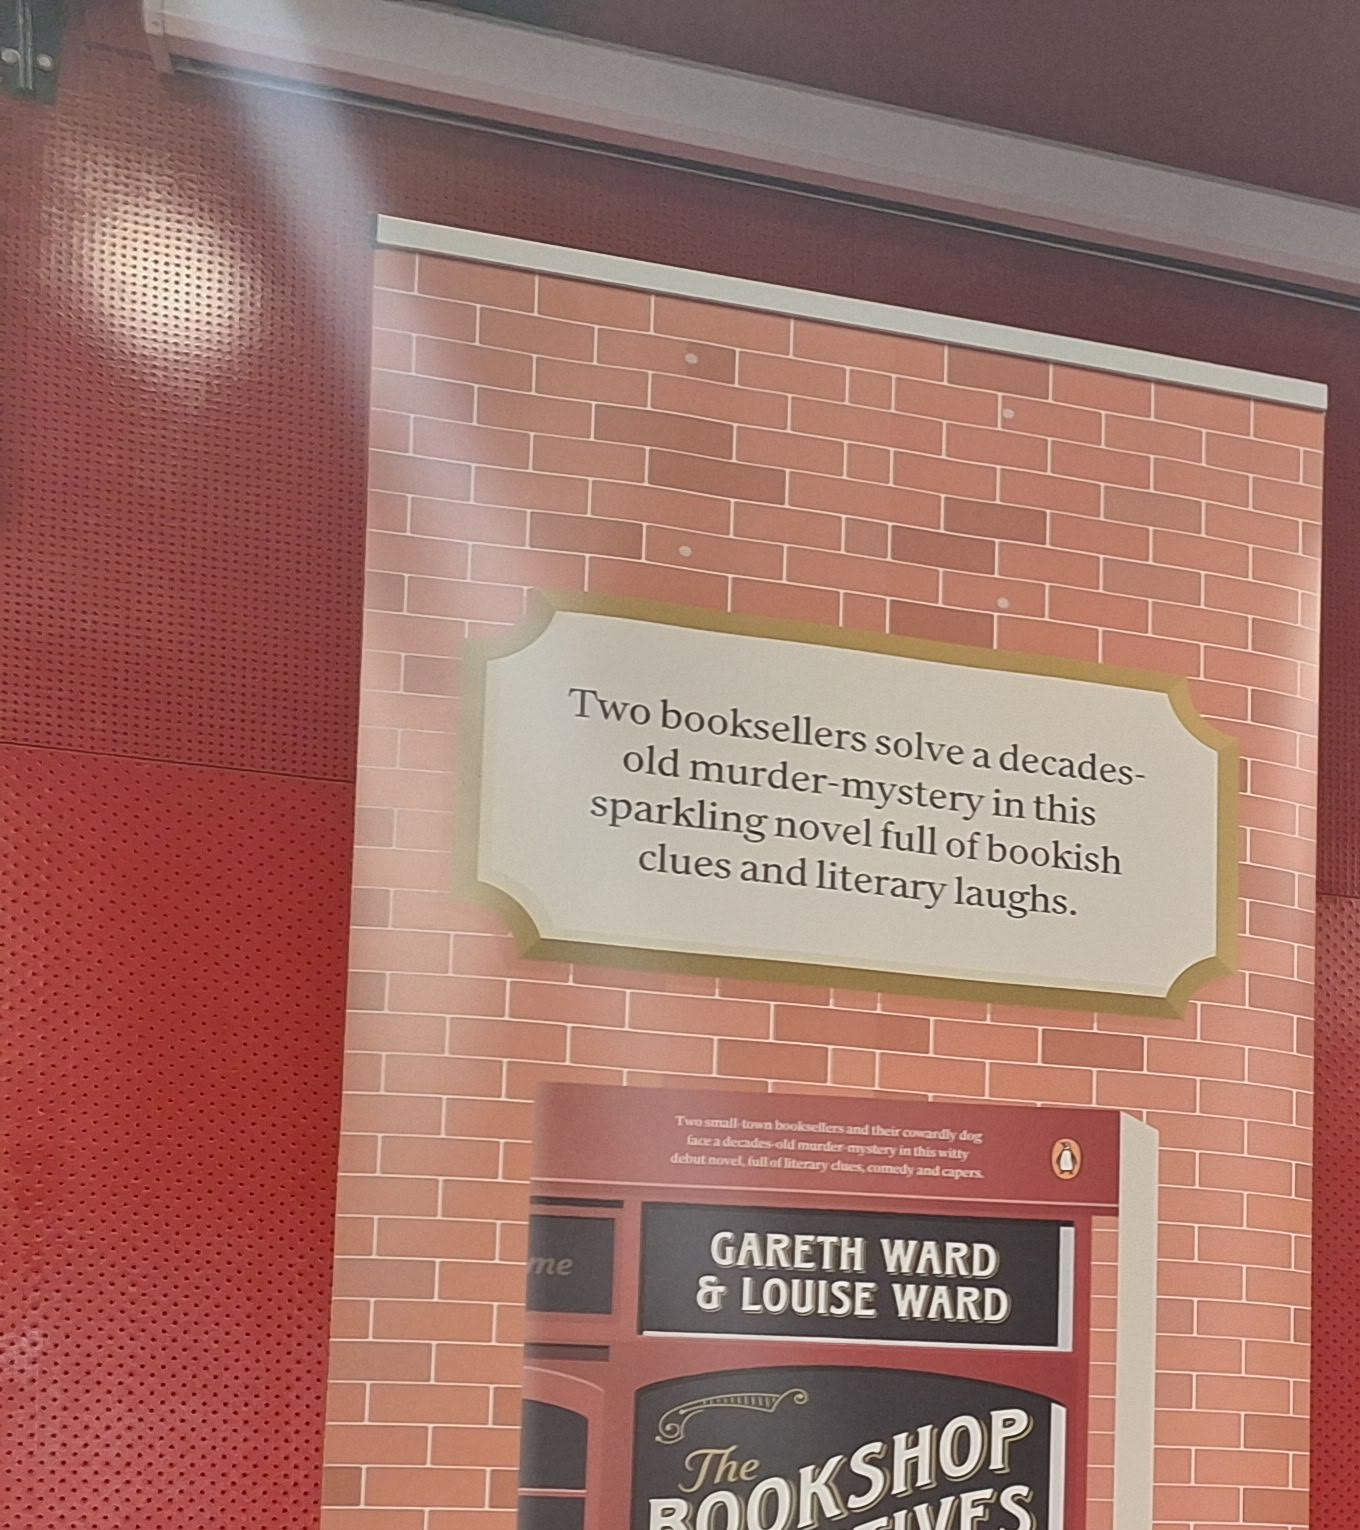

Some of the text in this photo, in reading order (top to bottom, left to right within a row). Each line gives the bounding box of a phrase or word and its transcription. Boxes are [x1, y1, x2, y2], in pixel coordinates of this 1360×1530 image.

[568, 688, 1147, 785] Two booksellers solve a decades-
[623, 745, 1097, 826] old murder-mystery in this
[590, 795, 1123, 875] sparkling novel full of bookish
[638, 843, 1077, 919] clues and literary laughs.
[674, 1115, 984, 1144] Two small-town booksellers and their cowardly dog
[687, 1135, 970, 1162] face a decades-old murder-mystery in this witty
[670, 1153, 985, 1181] debut novel, full of literary clues, comedy and capers.
[710, 1231, 1000, 1279] GARETH WARD
[696, 1274, 1012, 1324] & LOUISE WARD
[678, 1445, 761, 1493] The
